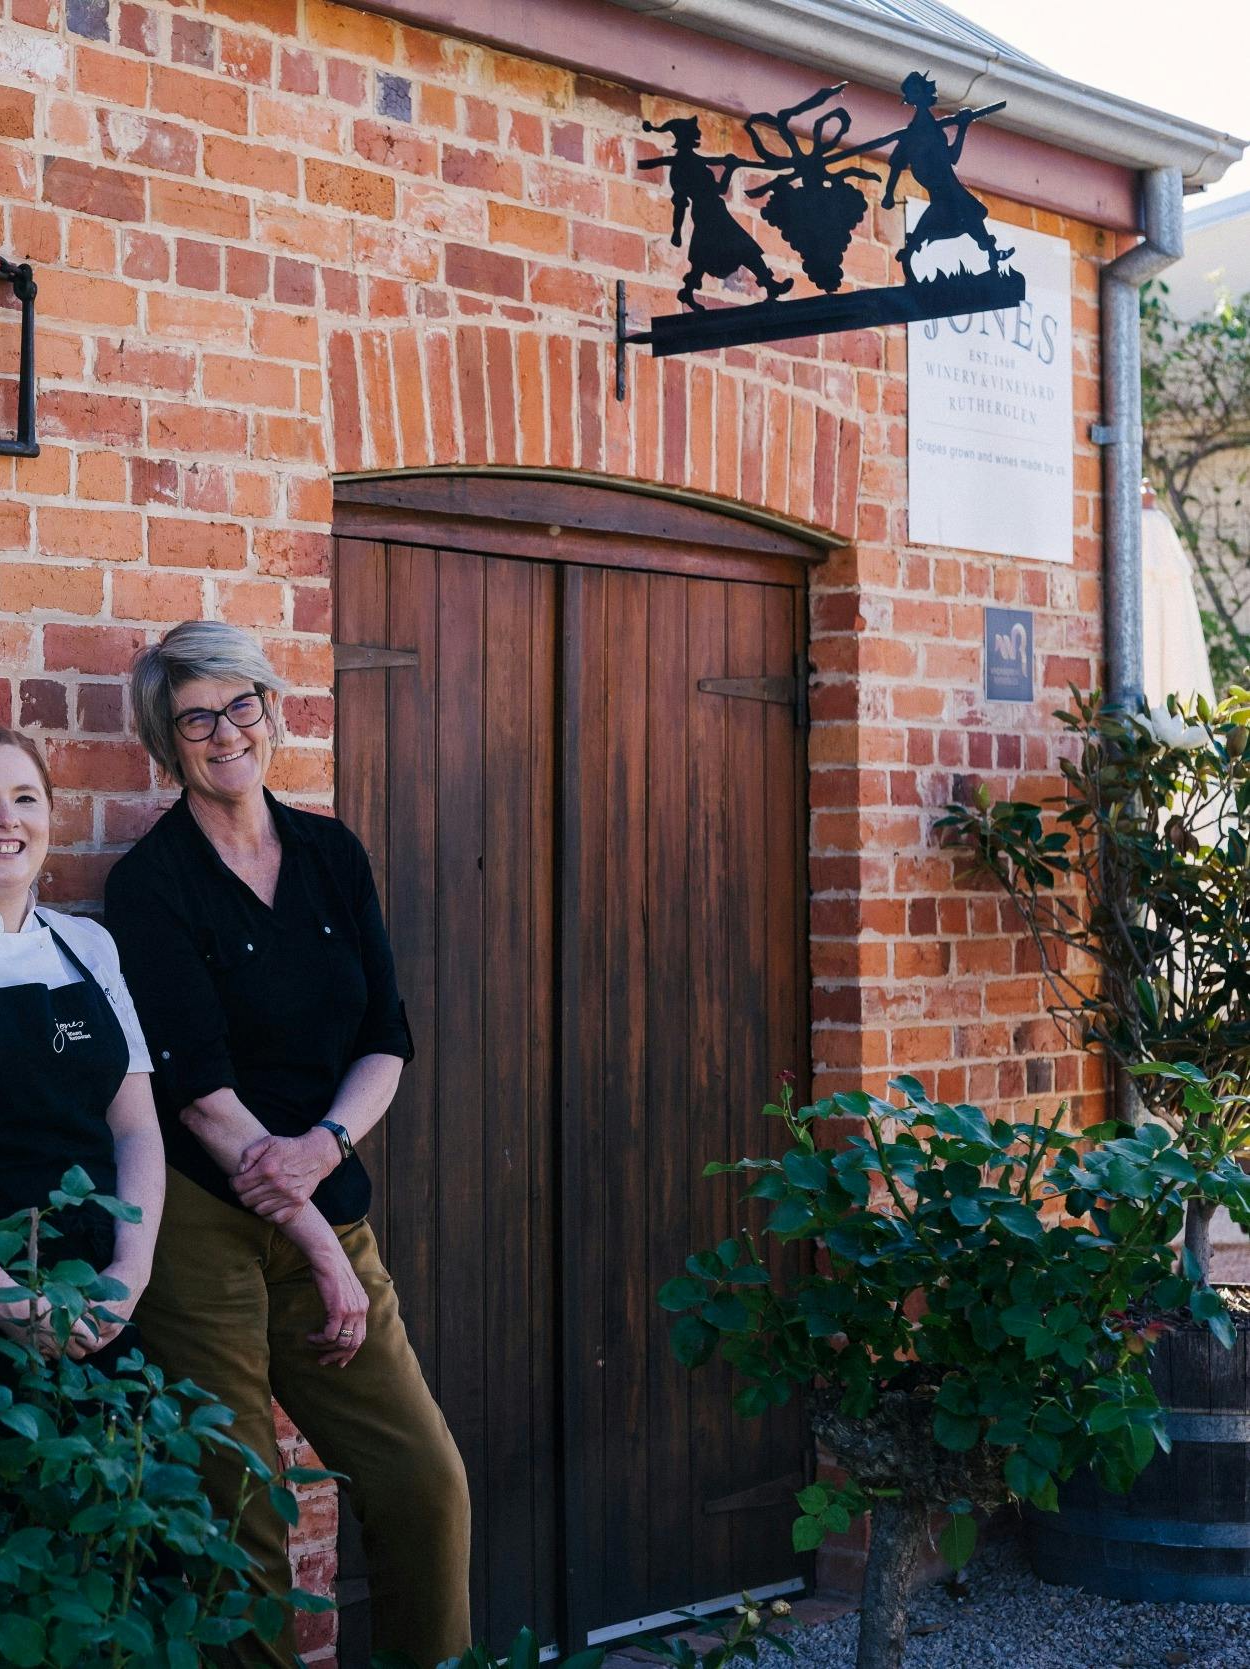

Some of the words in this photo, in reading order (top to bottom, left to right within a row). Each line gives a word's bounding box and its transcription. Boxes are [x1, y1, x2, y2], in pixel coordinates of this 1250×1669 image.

[949, 396, 1037, 425] RUTHERGLEN
[915, 438, 947, 456] Grapes
[949, 446, 975, 460] grown
[977, 450, 992, 463] and
[995, 454, 1017, 467] wines
